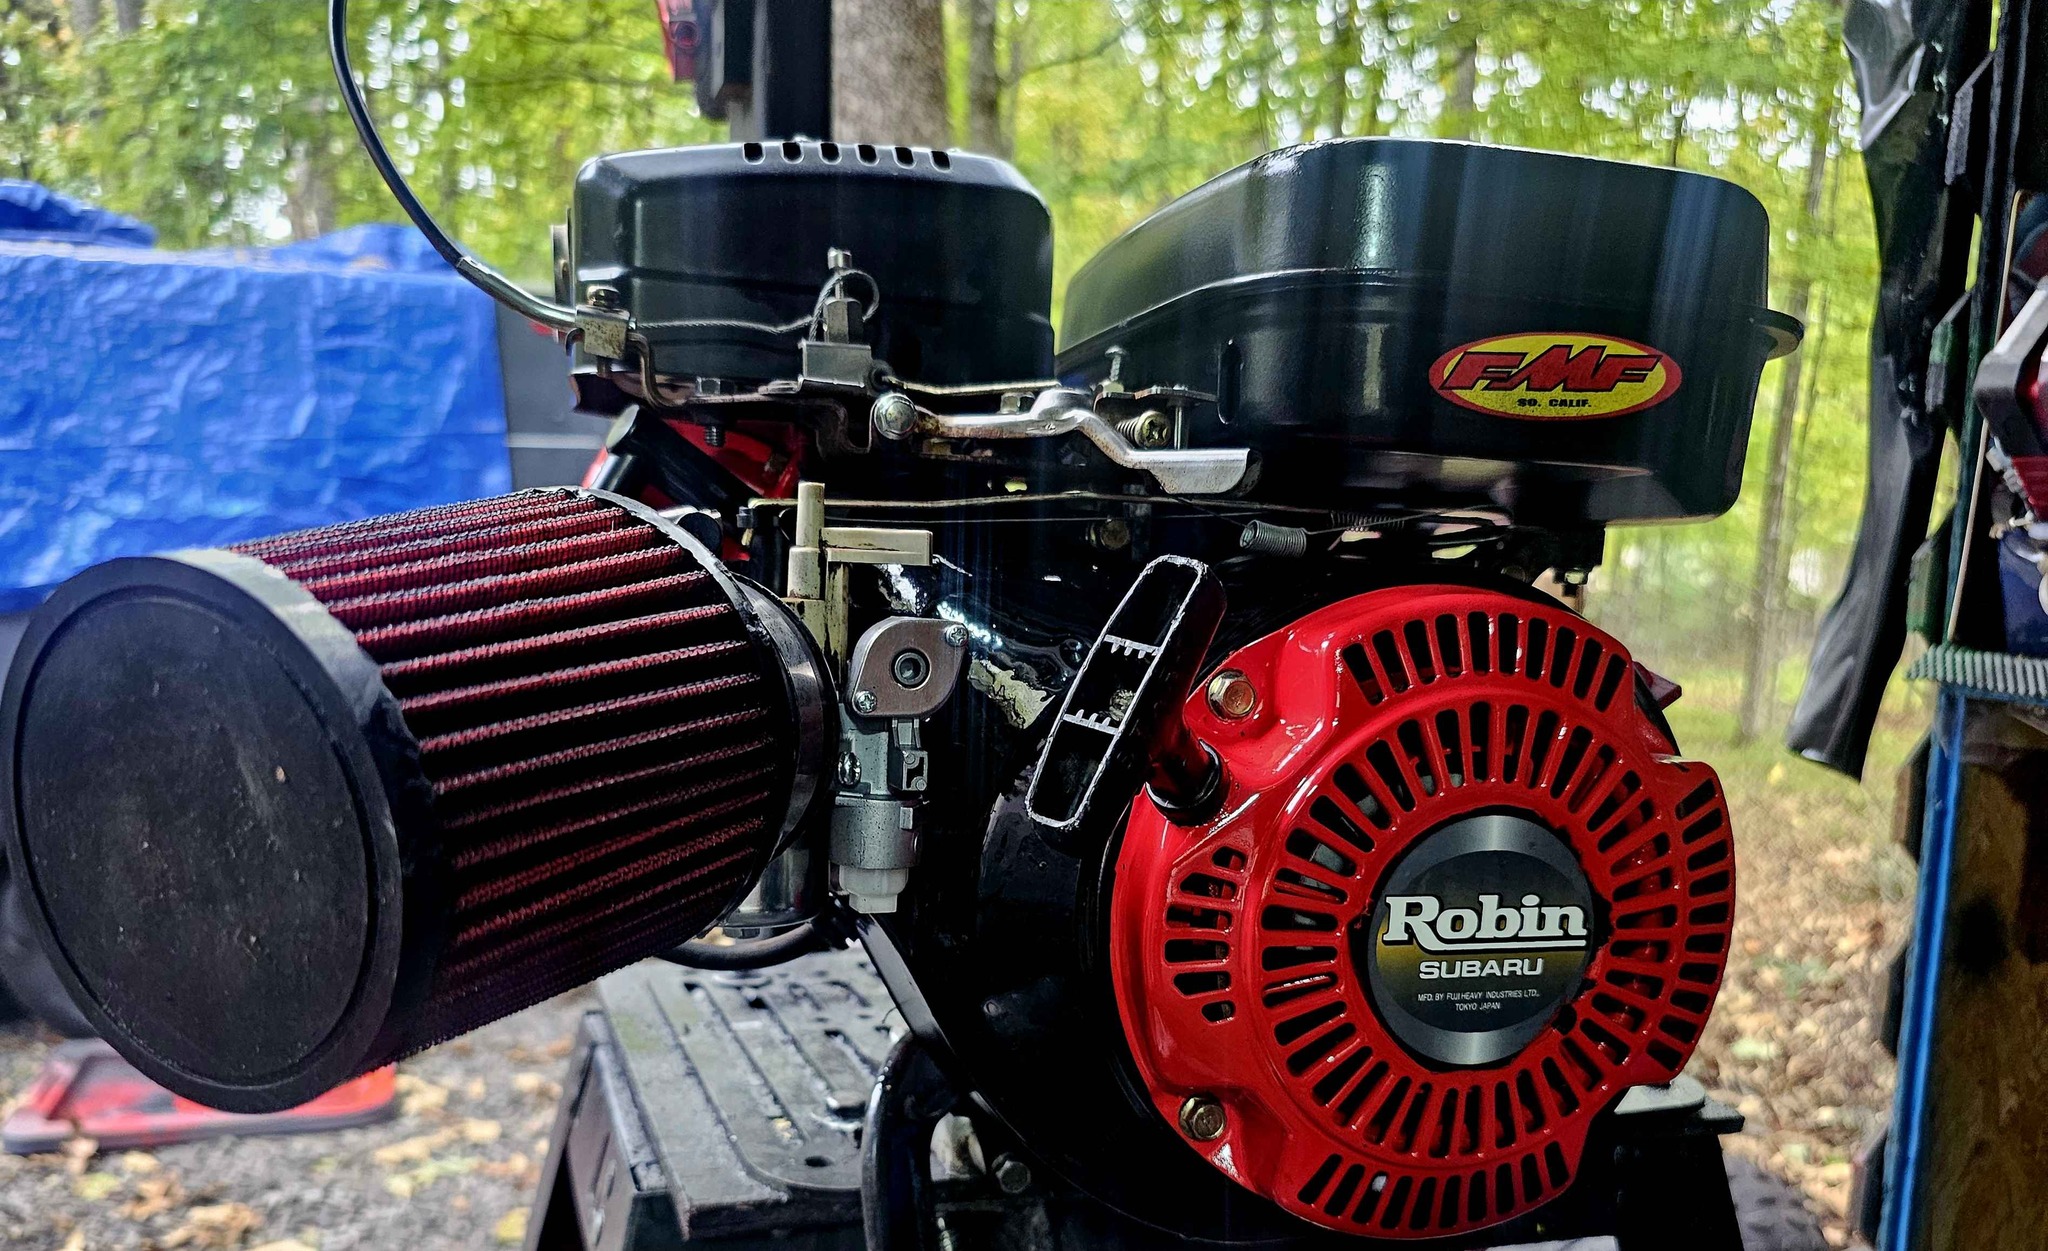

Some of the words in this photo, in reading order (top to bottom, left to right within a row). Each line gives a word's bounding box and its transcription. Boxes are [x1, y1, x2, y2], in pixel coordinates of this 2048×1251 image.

[1439, 344, 1663, 392] FMF
[1517, 398, 1541, 408] SO.
[1549, 398, 1592, 408] CALIF.
[1383, 895, 1588, 950] Robin
[1419, 958, 1543, 979] SUBARU
[1435, 993, 1444, 1001] BY
[1461, 991, 1482, 1000] HEAVY
[1486, 990, 1522, 999] INDUSTRIES
[1455, 1003, 1477, 1011] TOKYO
[1480, 1002, 1501, 1010] JAPAN
